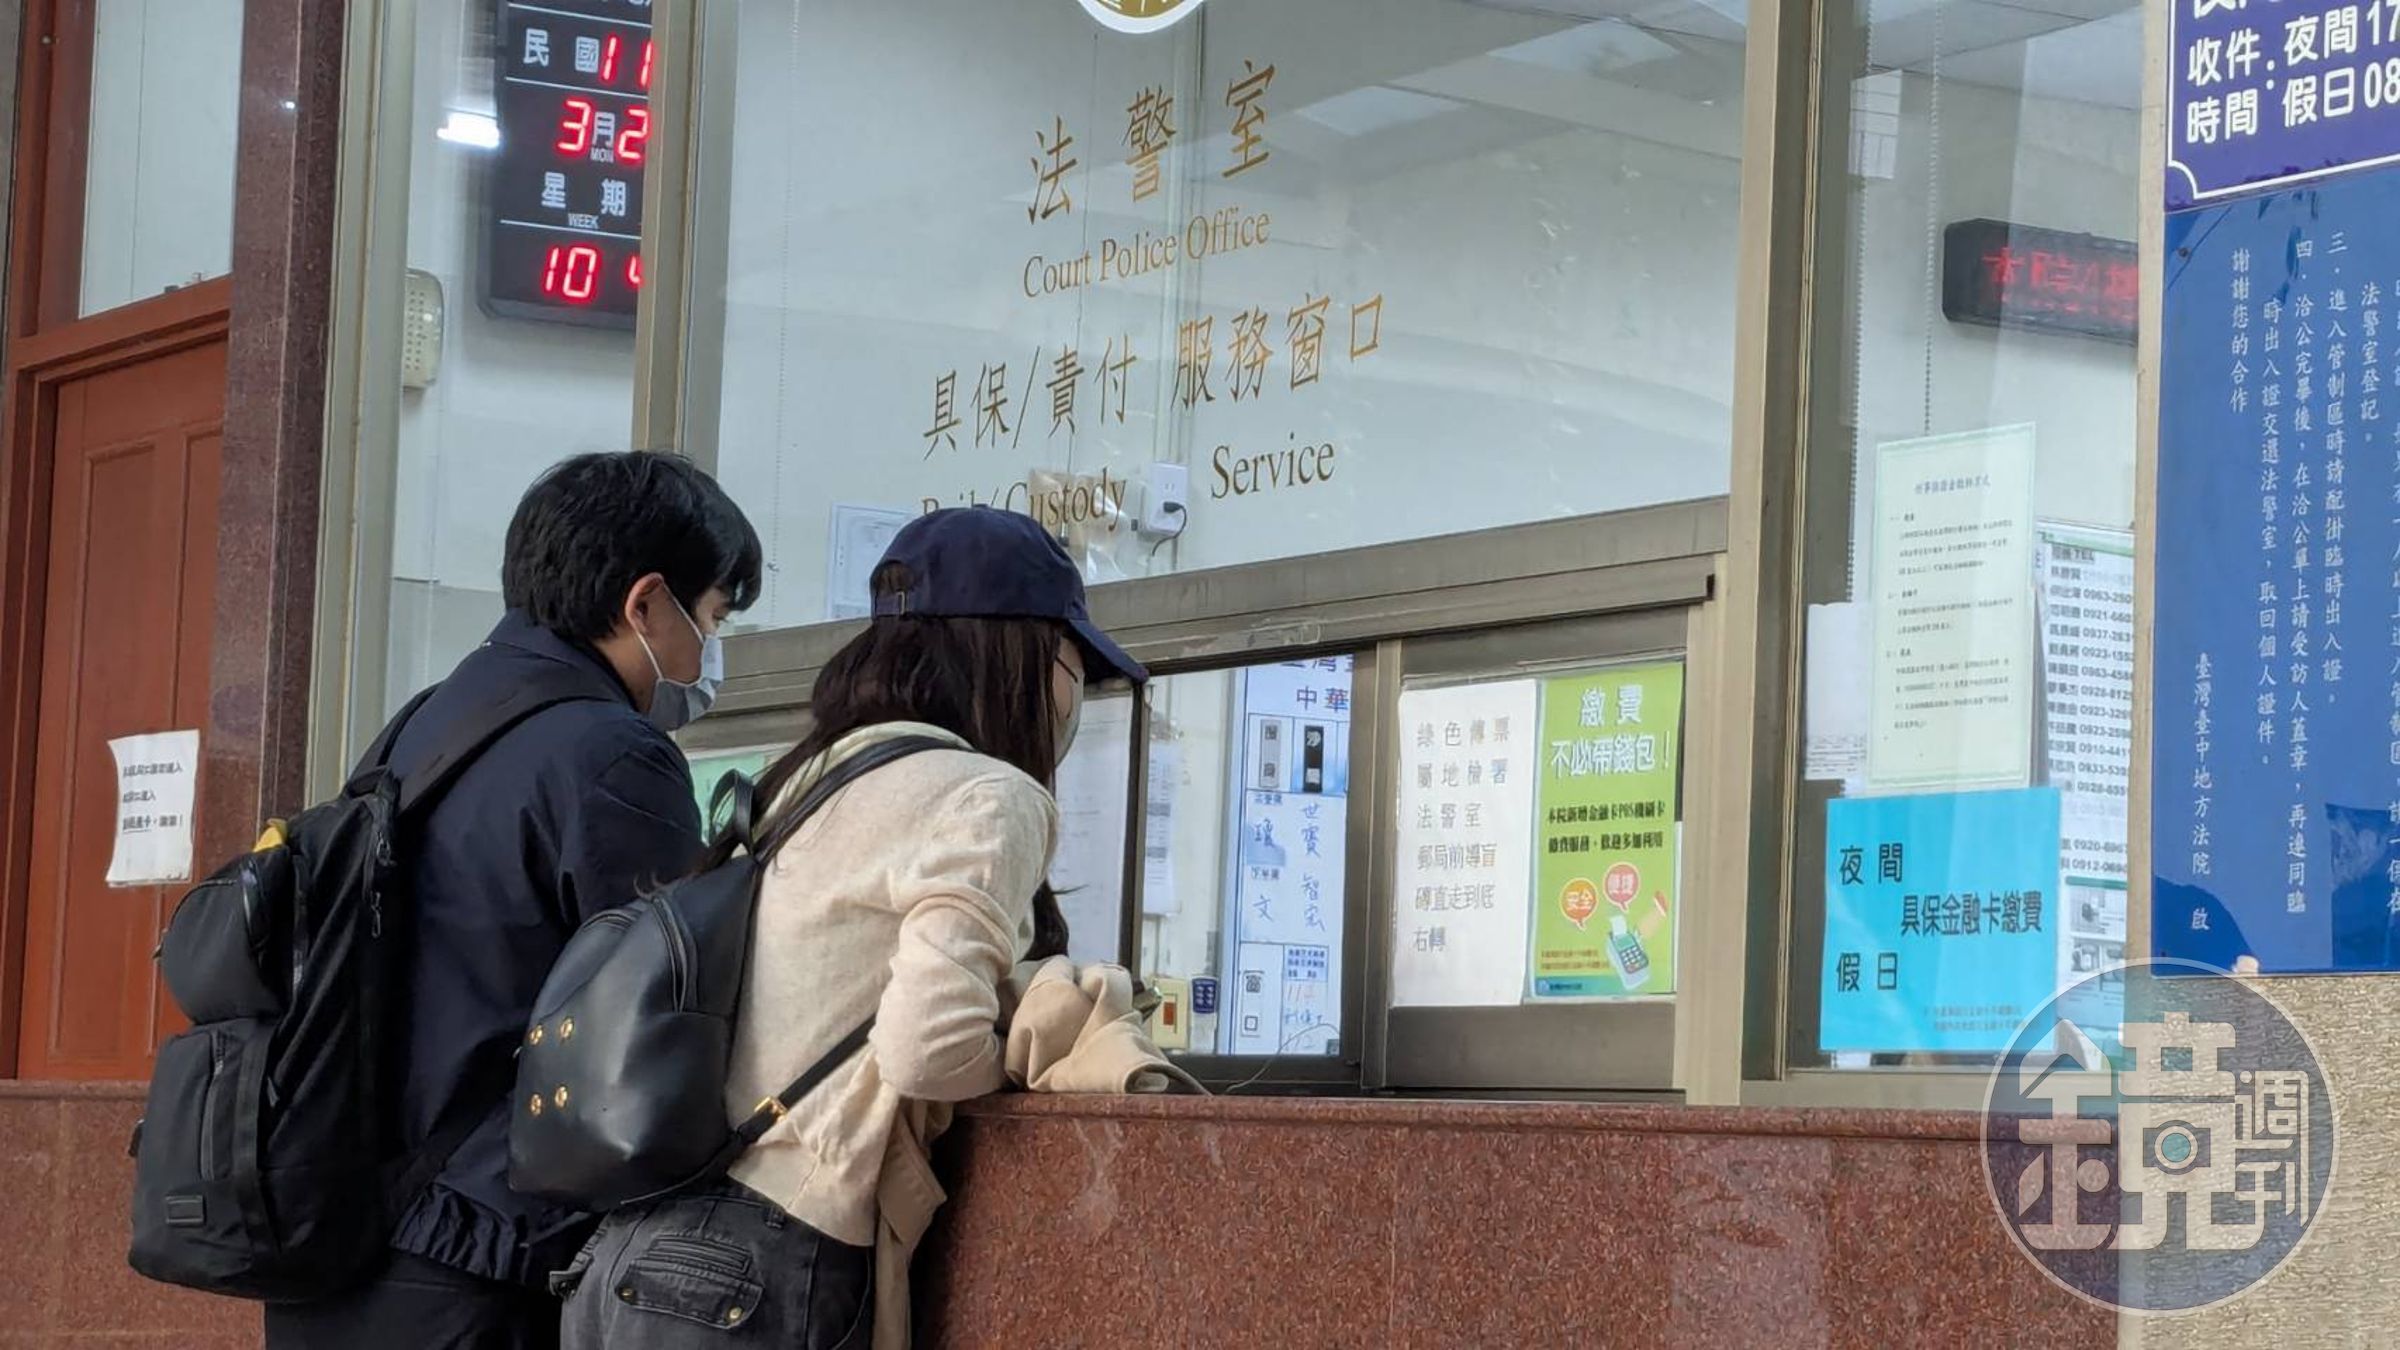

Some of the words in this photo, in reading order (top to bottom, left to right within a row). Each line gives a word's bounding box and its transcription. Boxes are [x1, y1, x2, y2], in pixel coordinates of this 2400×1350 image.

[590, 148, 616, 163] MON
[1027, 60, 1276, 225] 法警室
[541, 171, 627, 217] 星期
[568, 212, 600, 229] WEEK
[1023, 246, 1091, 298] Court
[1099, 226, 1178, 282] Police
[1186, 205, 1271, 260] Office
[1170, 292, 1383, 411] 服務窗口
[2229, 247, 2251, 414] 謝謝您的合作
[1210, 431, 1336, 500] Service
[1839, 842, 1904, 886] 夜間
[1900, 890, 2043, 937] 具保金融卡繳費
[1836, 952, 1899, 993] 假日
